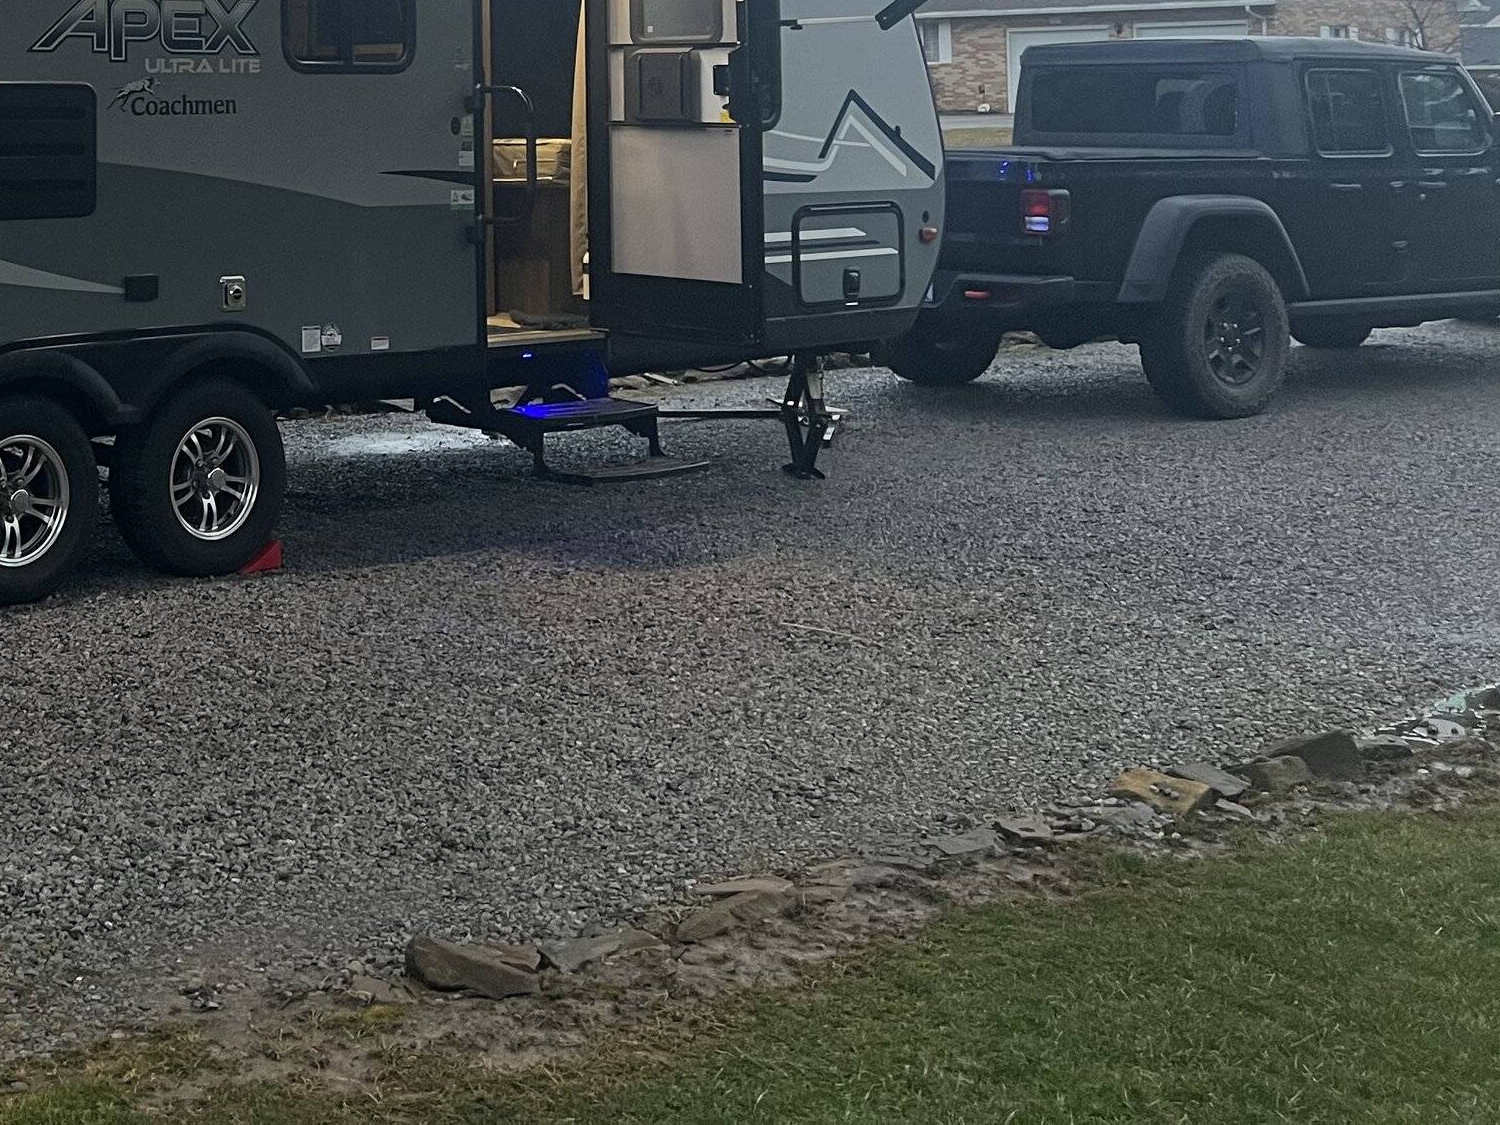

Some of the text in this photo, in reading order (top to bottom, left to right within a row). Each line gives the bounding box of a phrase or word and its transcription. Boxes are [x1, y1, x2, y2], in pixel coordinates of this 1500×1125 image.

[145, 59, 261, 74] ULTRA LITE
[131, 95, 237, 116] Coachmen
